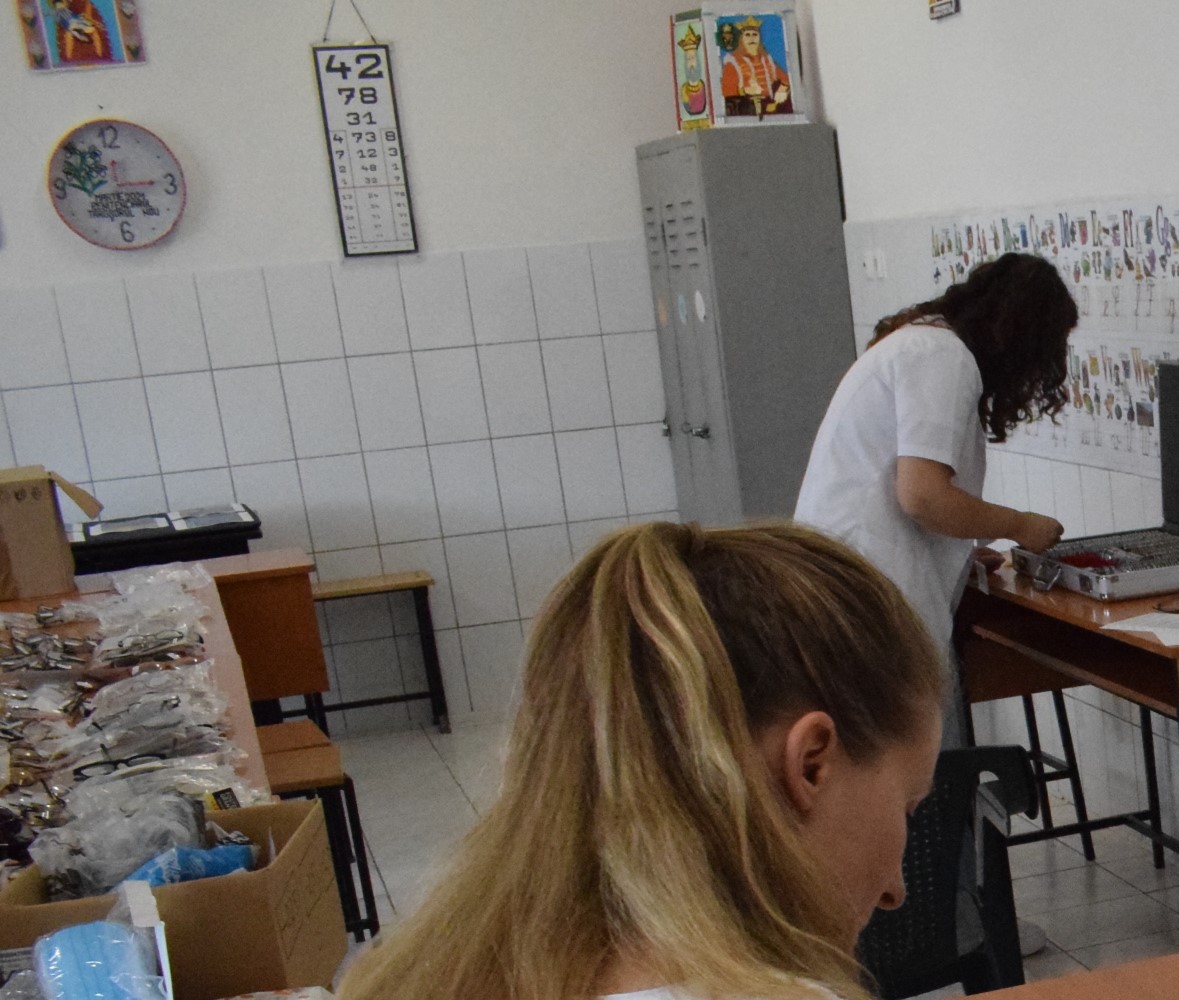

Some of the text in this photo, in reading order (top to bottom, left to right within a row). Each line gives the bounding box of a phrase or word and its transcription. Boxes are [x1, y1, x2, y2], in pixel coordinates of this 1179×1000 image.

[325, 53, 384, 80] 42
[337, 87, 378, 105] 78
[346, 112, 377, 126] 31
[98, 125, 121, 148] 12
[333, 131, 396, 143] 4 73 8
[335, 147, 398, 159] 7 12 3
[54, 177, 67, 200] 9
[163, 172, 178, 195] 3
[119, 221, 135, 243] 6
